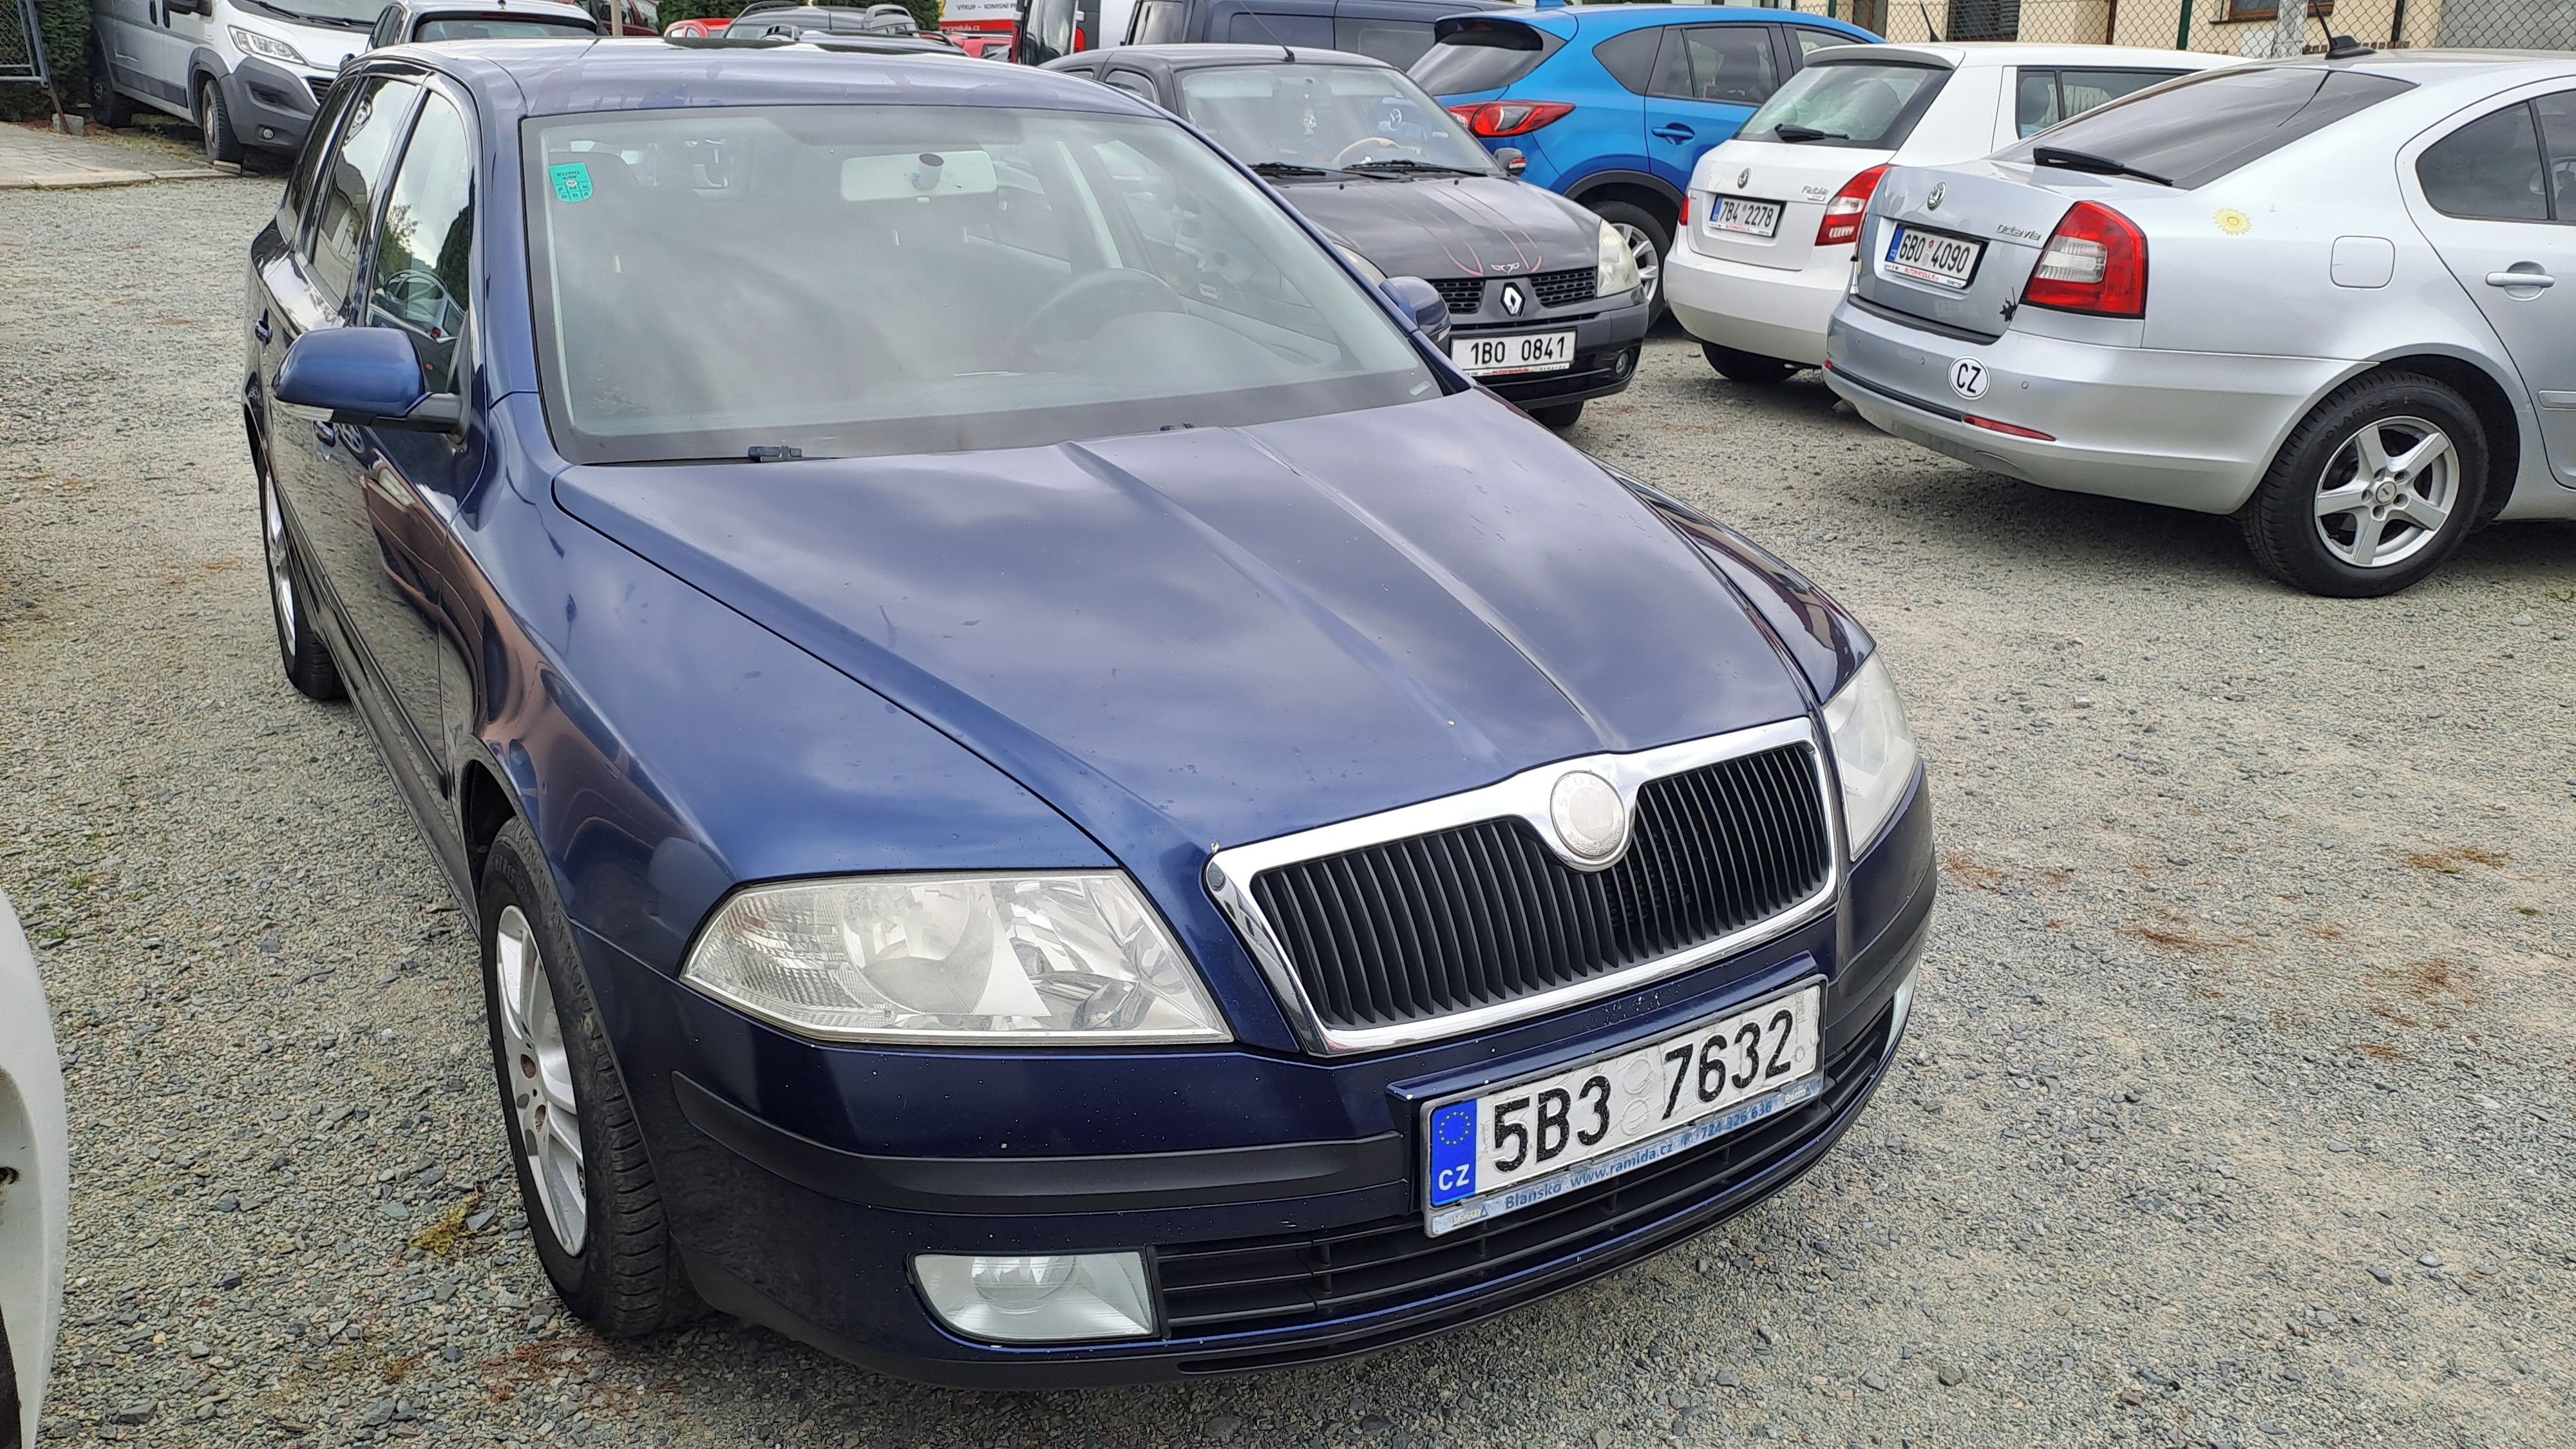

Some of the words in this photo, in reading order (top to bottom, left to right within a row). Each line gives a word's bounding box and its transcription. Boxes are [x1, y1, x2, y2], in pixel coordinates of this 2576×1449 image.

[1719, 201, 1741, 223] 7B4
[1745, 205, 1774, 228] 2278
[1996, 223, 2043, 241] Octavia
[1899, 233, 1926, 263] 6B0
[1931, 240, 1971, 274] 4090
[1471, 341, 1506, 365] 1B0
[1521, 336, 1565, 362] 0841
[1956, 363, 1982, 394] CZ
[1493, 1075, 1612, 1175] 5B3
[1661, 1009, 1794, 1121] 7632
[1438, 1163, 1470, 1191] CZ
[1505, 1182, 1562, 1210] Blansko
[1570, 1144, 1673, 1188] www.ramida.cz
